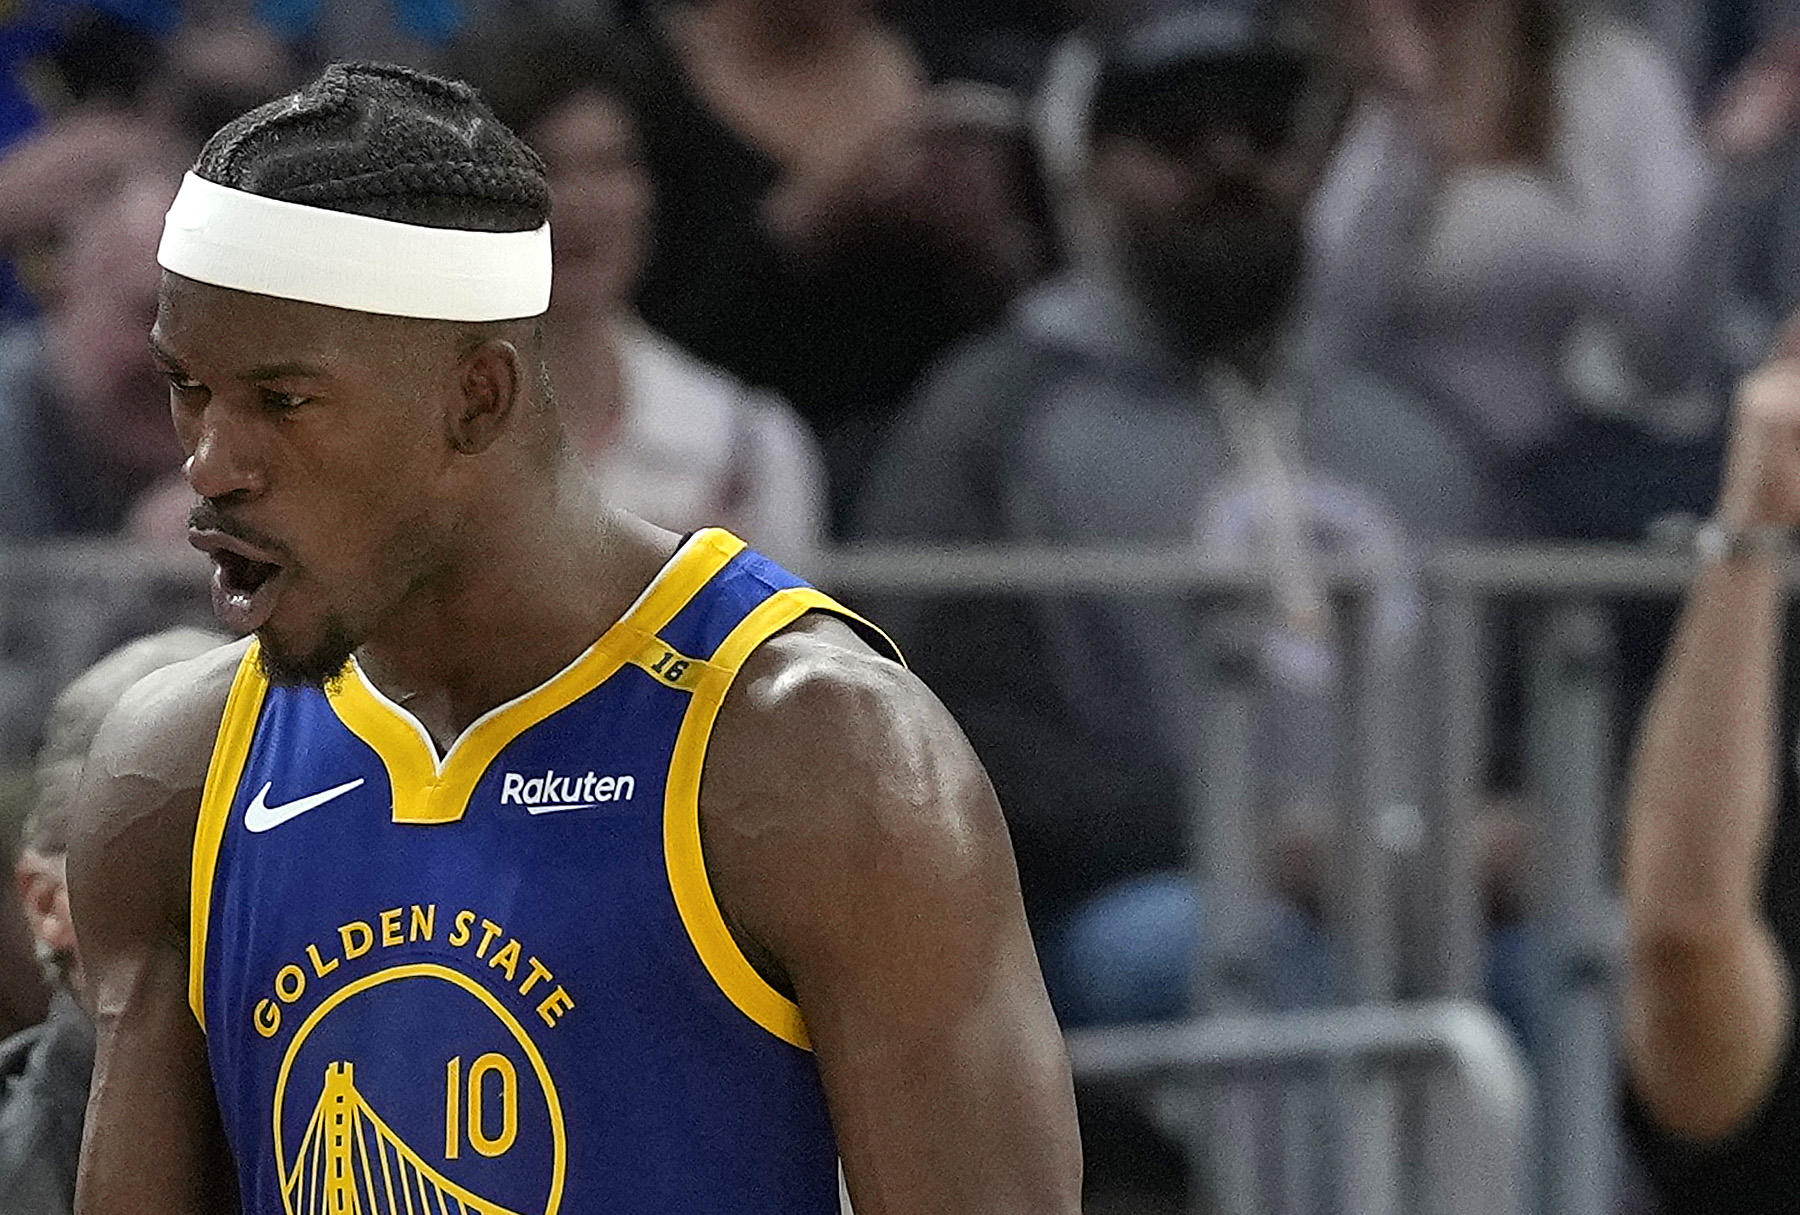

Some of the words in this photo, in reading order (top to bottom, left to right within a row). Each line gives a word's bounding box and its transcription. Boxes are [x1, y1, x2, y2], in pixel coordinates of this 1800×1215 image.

[651, 652, 689, 682] 16
[501, 770, 635, 805] Rakuten
[253, 904, 436, 1038] GOLDEN
[449, 910, 576, 1029] STATE
[445, 1052, 519, 1160] 10
